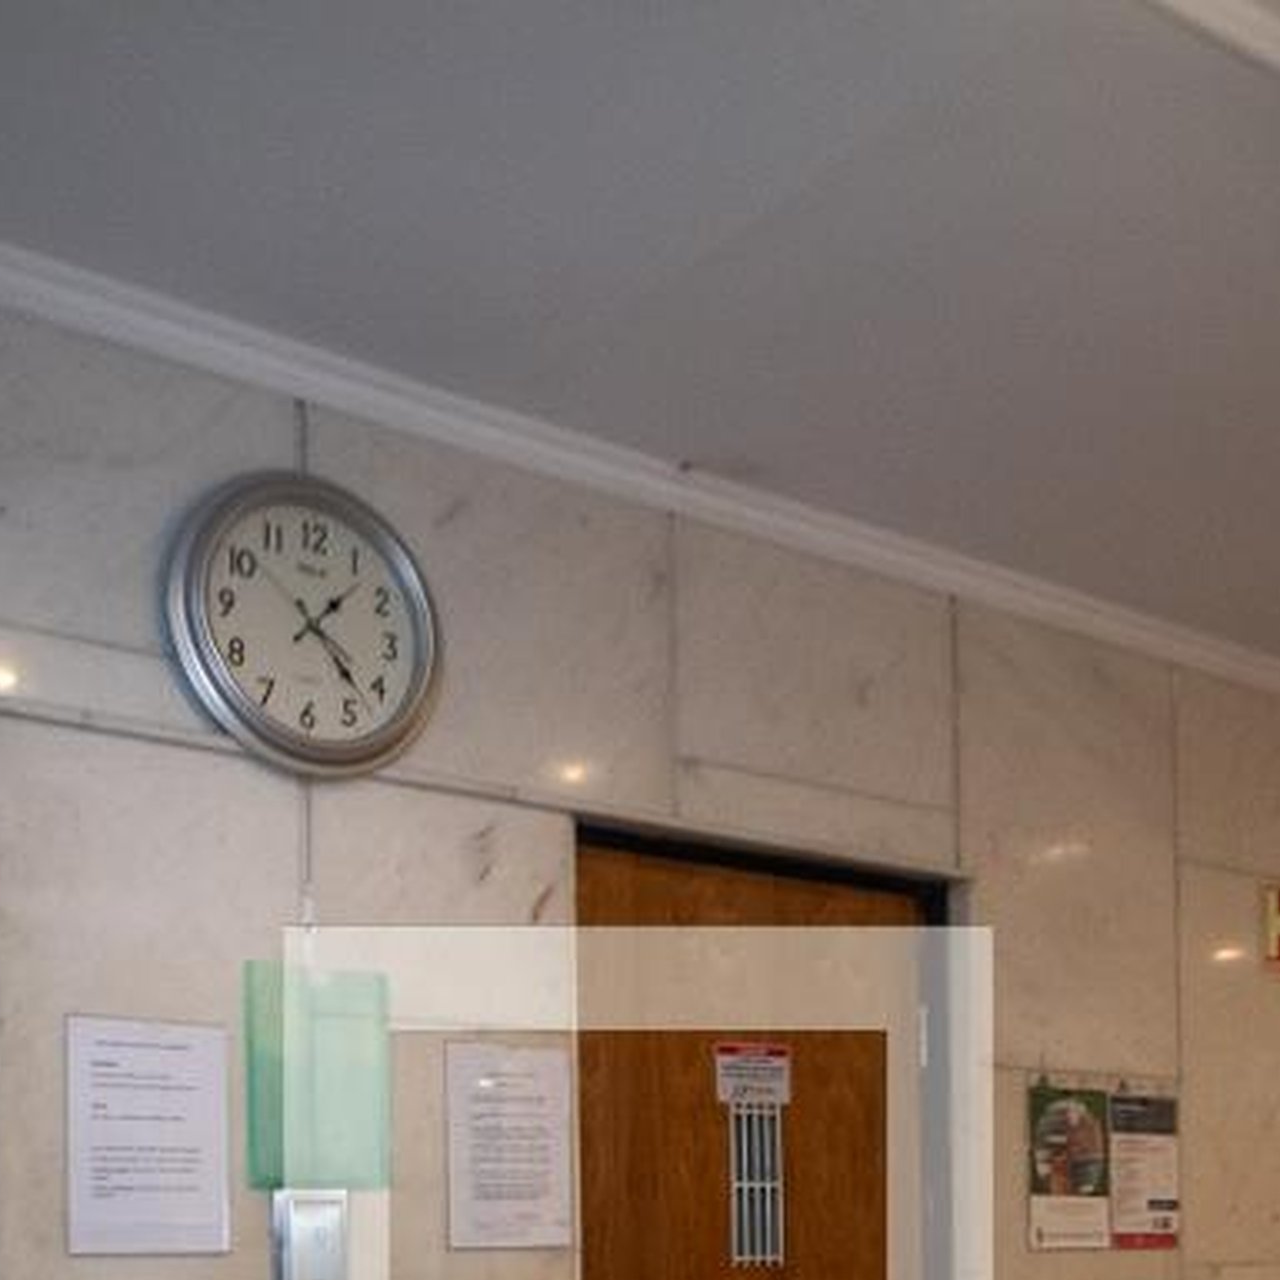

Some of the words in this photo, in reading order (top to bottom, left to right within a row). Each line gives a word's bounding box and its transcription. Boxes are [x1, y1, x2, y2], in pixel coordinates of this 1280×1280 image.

[263, 521, 283, 555] 11
[301, 521, 328, 556] 12
[228, 546, 257, 579] 10
[351, 548, 359, 576] 1
[218, 587, 235, 618] 9
[375, 586, 390, 618] 2
[228, 636, 245, 667] 8
[382, 632, 398, 661] 3
[256, 676, 275, 707] 7
[370, 676, 385, 703] 4
[299, 699, 316, 730] 6
[341, 698, 358, 727] 5
